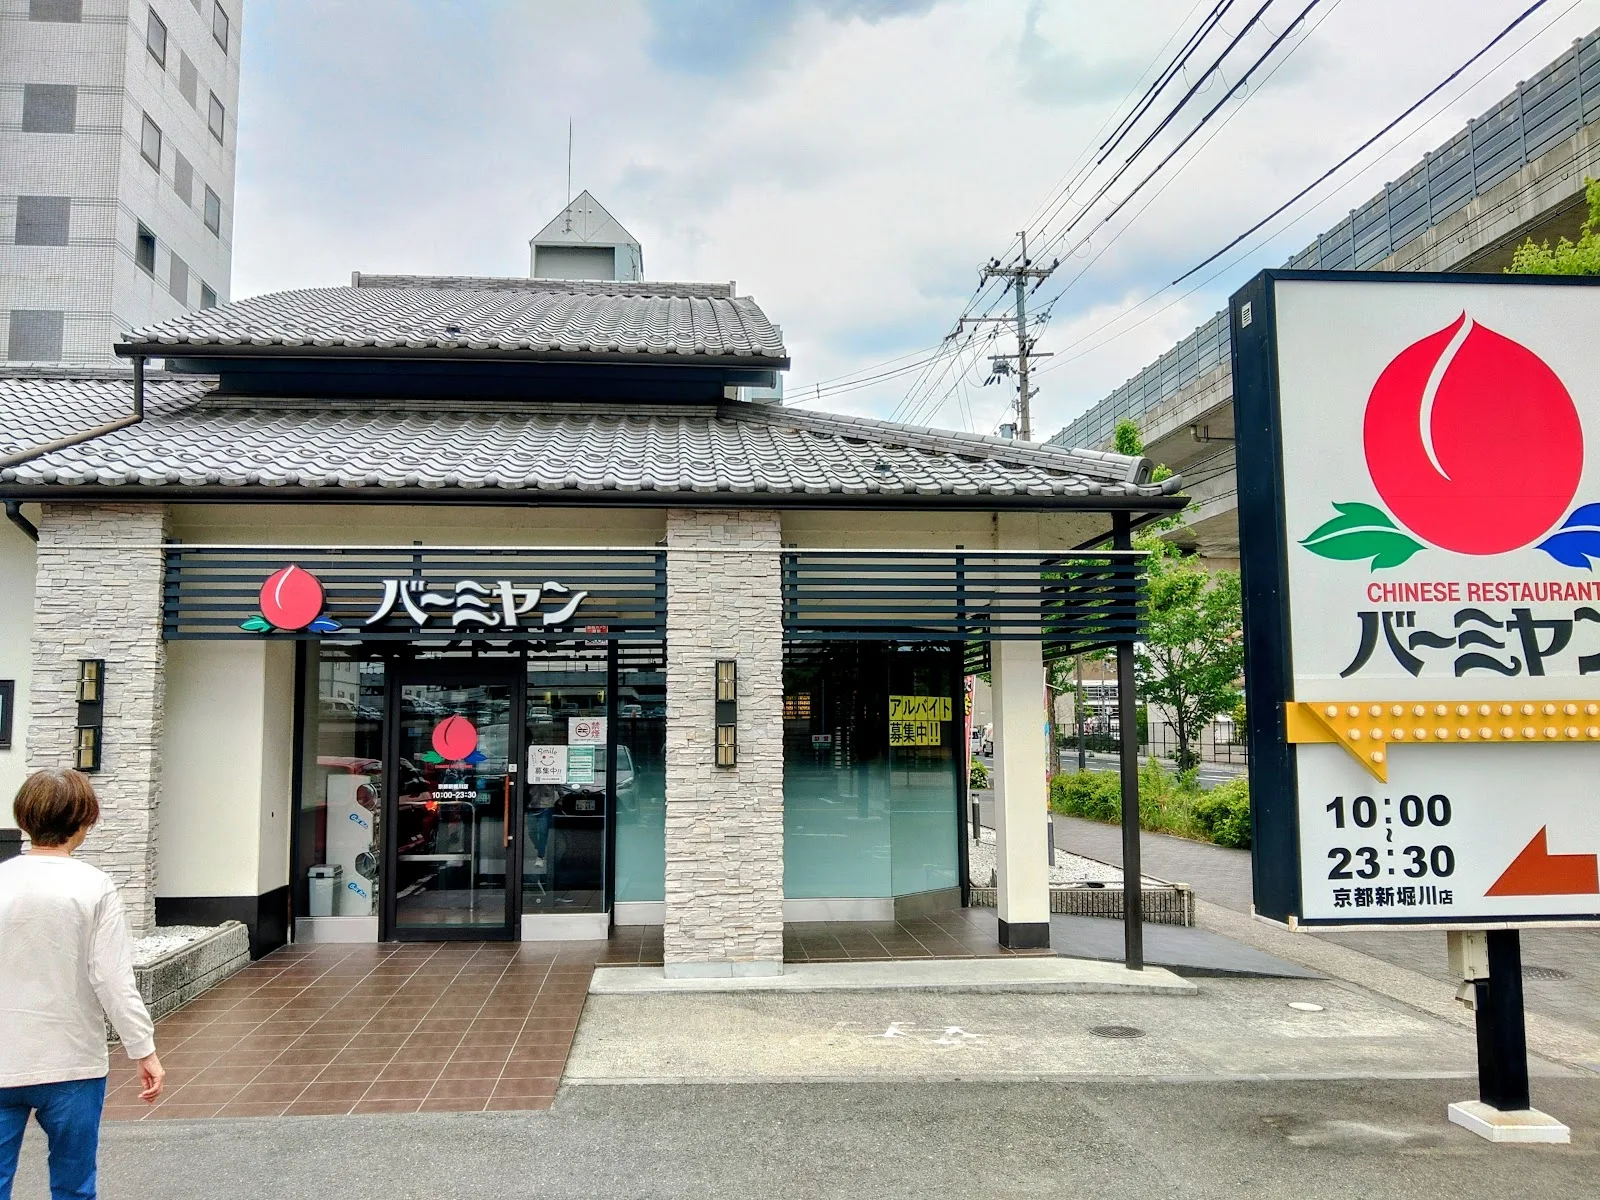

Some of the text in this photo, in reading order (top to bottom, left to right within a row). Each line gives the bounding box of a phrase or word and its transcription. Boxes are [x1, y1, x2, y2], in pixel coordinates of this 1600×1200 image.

[365, 579, 589, 627] バーミヤン
[1367, 582, 1600, 603] CHINESE RESTAURANT
[890, 698, 950, 718] アルバイト
[890, 721, 938, 743] 募集中!!
[1326, 794, 1452, 829] 10:00
[1327, 845, 1456, 881] 23:30
[1332, 885, 1453, 908] 京都新堀川店
